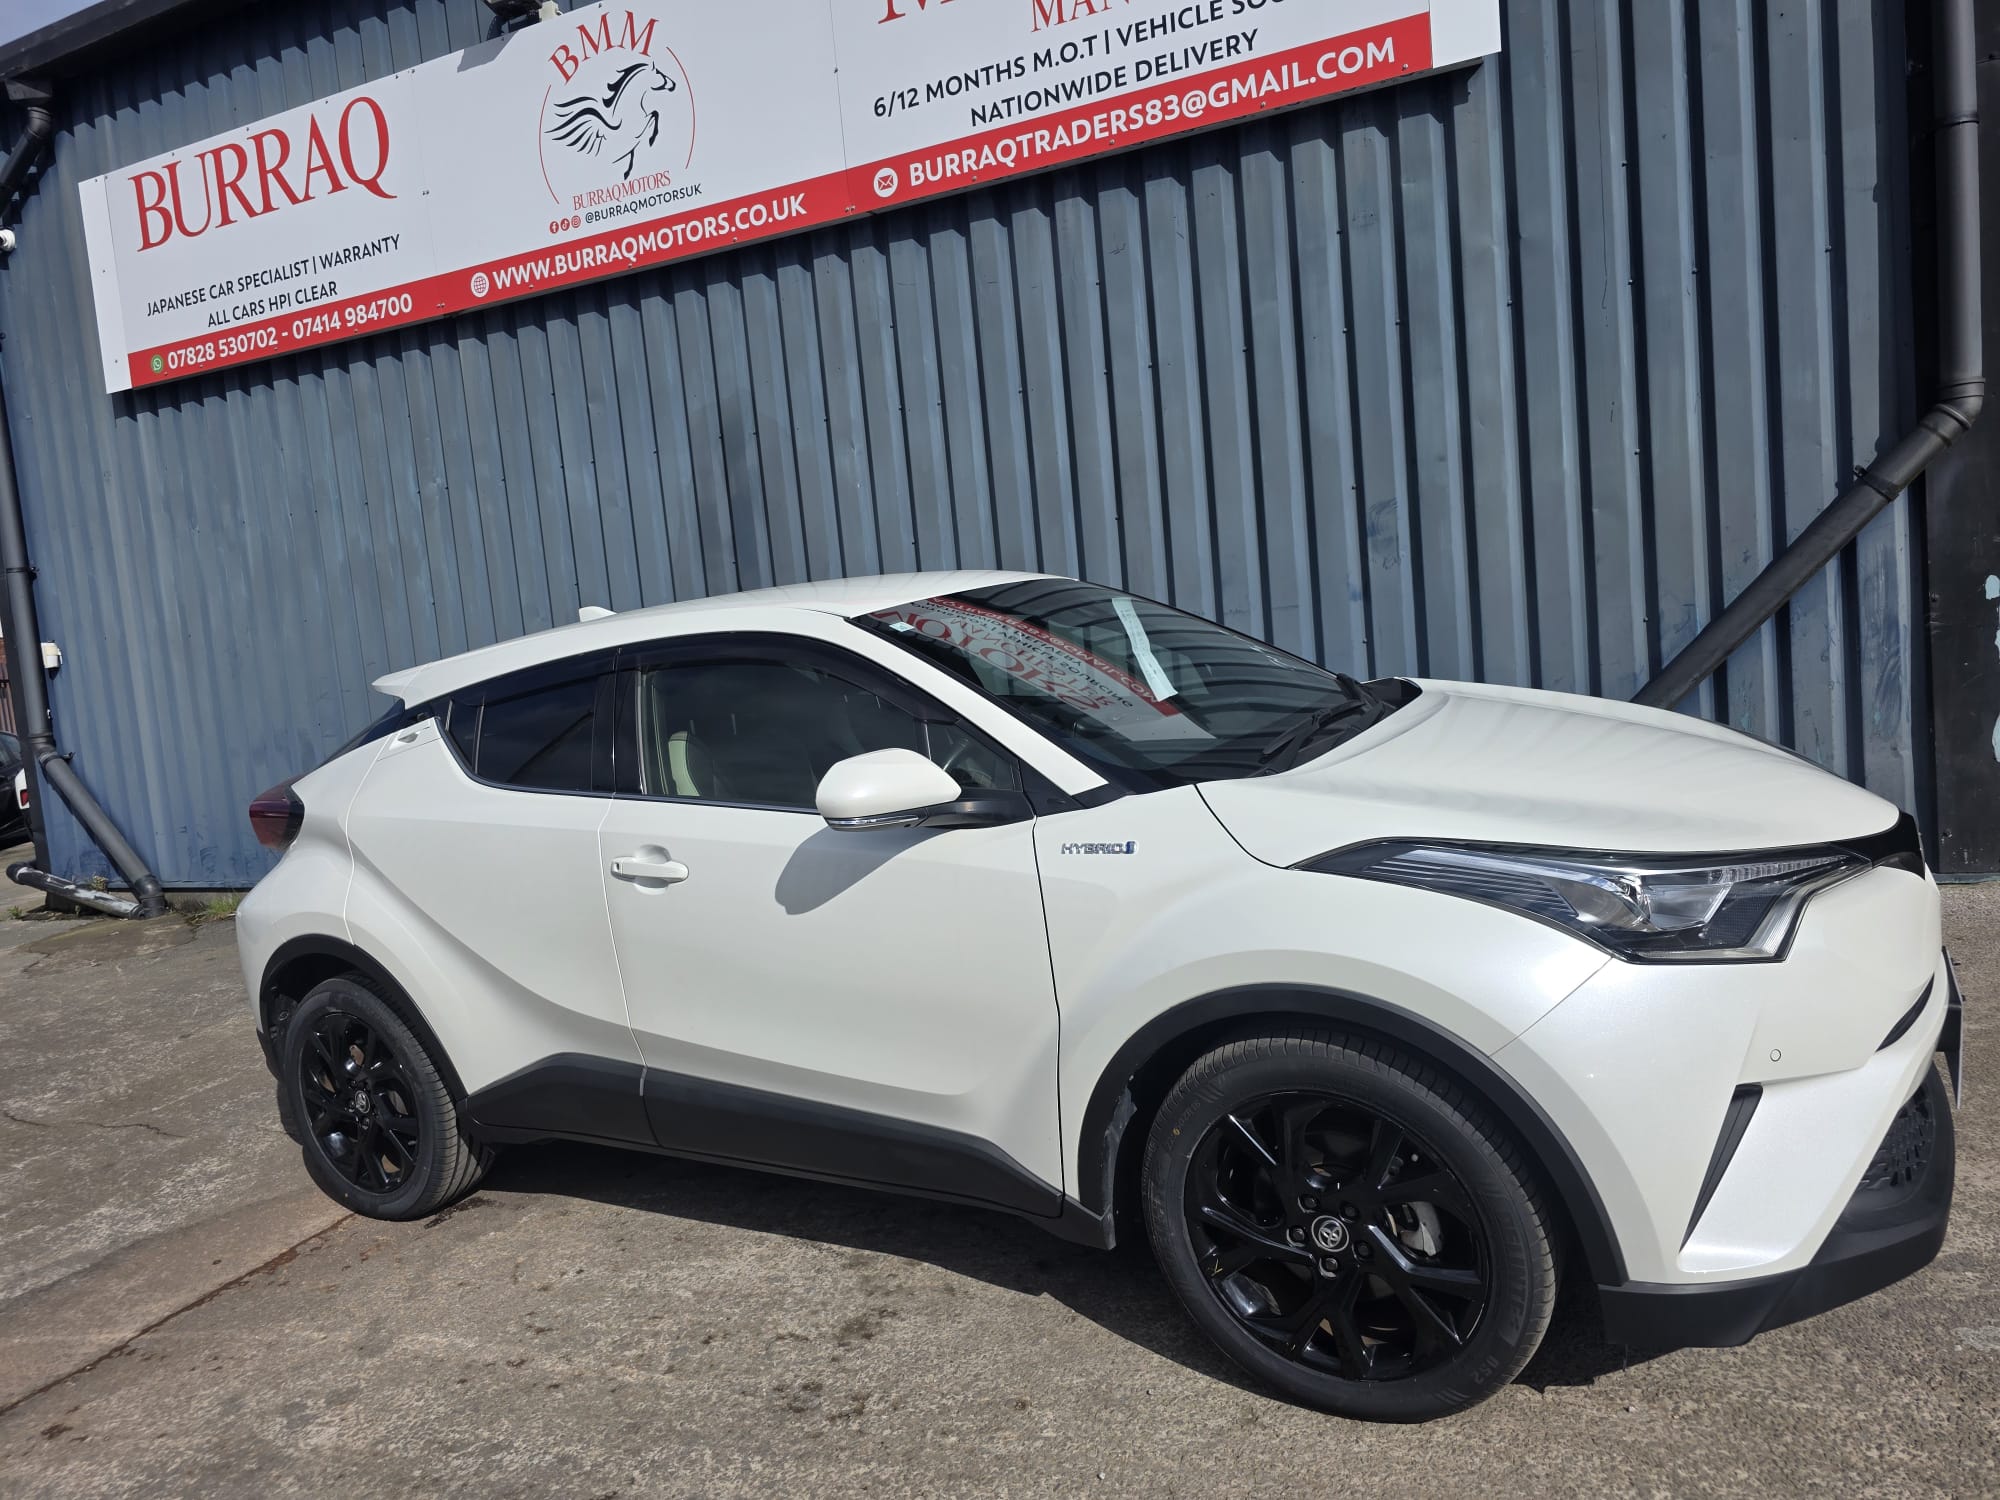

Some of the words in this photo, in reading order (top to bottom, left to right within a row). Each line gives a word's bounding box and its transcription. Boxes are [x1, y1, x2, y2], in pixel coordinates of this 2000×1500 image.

[548, 9, 660, 85] BMM
[873, 88, 920, 117] 6/12
[925, 56, 1026, 103] MONTHS
[1033, 35, 1097, 72] M.O.T
[1116, 0, 1224, 48] VEHICLE
[970, 65, 1127, 127] NATIONWIDE
[1135, 28, 1258, 82] DELIVERY
[909, 36, 1395, 188] BURRAQTRADERS83@GMAIL.COM
[128, 96, 397, 252] BURRAQ
[585, 183, 702, 223] @BURRAQMOTORSUK
[147, 288, 206, 317] JAPANESE
[209, 280, 234, 299] CAR
[238, 259, 309, 294] SPECIALIST
[319, 233, 400, 268] WARRANTY
[493, 193, 807, 290] WWW.BURRAQMOTORS.CO.UK
[167, 342, 215, 370] 07828
[219, 327, 278, 358] 530702
[292, 311, 341, 340] 07414
[344, 293, 413, 327] 984700
[208, 310, 231, 327] ALL
[233, 301, 265, 320] CARS
[269, 293, 291, 312] HPI
[295, 281, 338, 304] CLEAR
[1061, 842, 1124, 855] HYBRID
